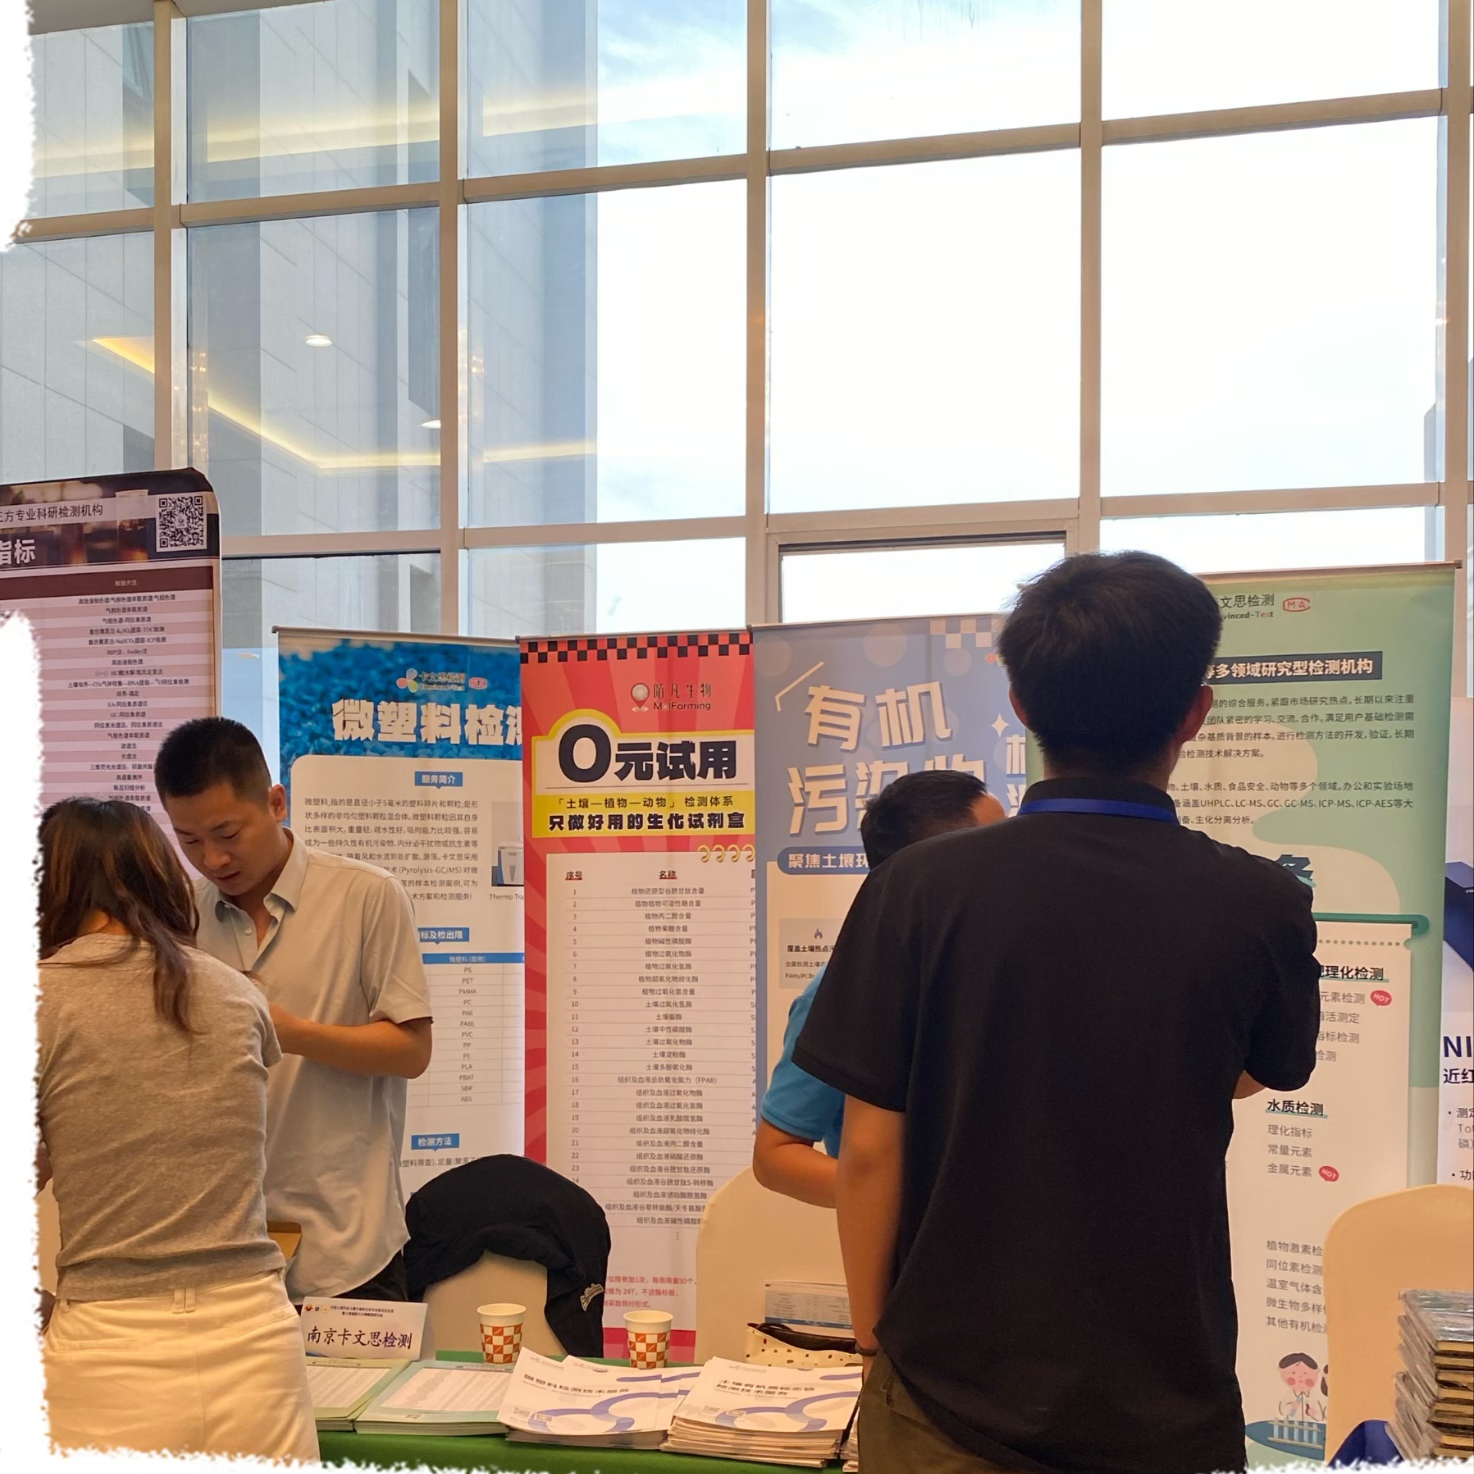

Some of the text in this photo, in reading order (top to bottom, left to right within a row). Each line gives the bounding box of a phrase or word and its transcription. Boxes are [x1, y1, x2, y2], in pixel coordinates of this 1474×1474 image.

[1216, 594, 1274, 608] 文思检测
[654, 683, 712, 698] 陌凡生物
[805, 681, 952, 751] 有机
[559, 724, 737, 782] 0元试用
[422, 775, 456, 784] 服务简介
[684, 796, 734, 807] 检测体系
[548, 812, 745, 831] 只做好用的生化试剂盒
[566, 870, 677, 879] 序号 名称
[1267, 1099, 1324, 1116] 水质检测
[1267, 1125, 1313, 1139] 理化指标
[418, 1137, 451, 1146] 检测方法
[1267, 1144, 1313, 1158] 常量元素
[1267, 1163, 1312, 1178] 金属元素
[307, 1326, 412, 1350] 南京卡文思检测
